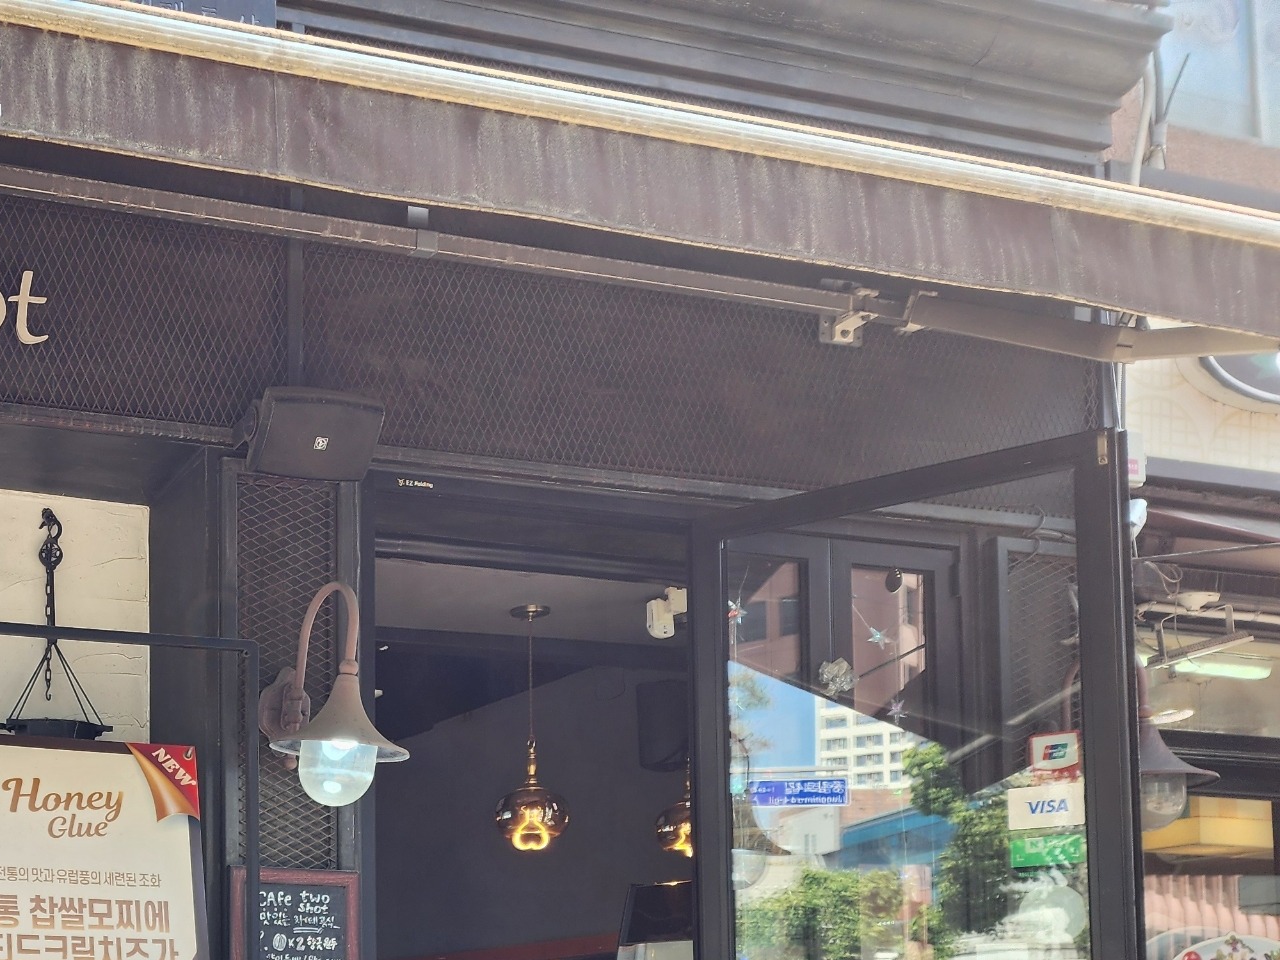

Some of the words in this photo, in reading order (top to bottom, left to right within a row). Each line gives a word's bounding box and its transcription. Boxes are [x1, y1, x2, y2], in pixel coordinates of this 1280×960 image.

[151, 748, 197, 787] NEW
[1, 777, 124, 823] Honey
[1026, 799, 1069, 814] VISA
[47, 814, 108, 839] Glue
[31, 867, 54, 884] 맛과
[56, 868, 101, 886] 유럽풍의
[103, 870, 137, 888] 세련된
[138, 872, 162, 889] 조화
[300, 890, 330, 904] two
[29, 894, 170, 933] 찹쌀모찌에
